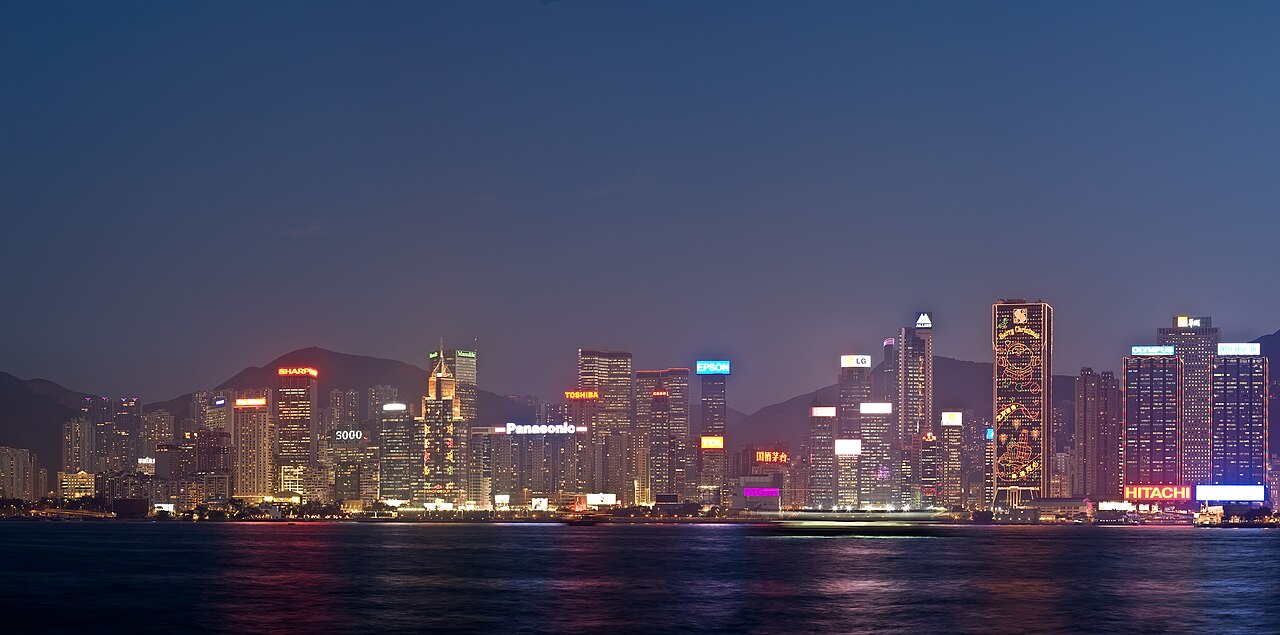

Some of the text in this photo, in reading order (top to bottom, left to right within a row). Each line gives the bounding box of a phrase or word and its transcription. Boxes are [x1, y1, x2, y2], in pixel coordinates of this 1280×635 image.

[698, 363, 730, 372] EPSON
[506, 422, 576, 434] Panasonic
[336, 430, 362, 440] SOGO
[1125, 487, 1190, 498] HITACHI
